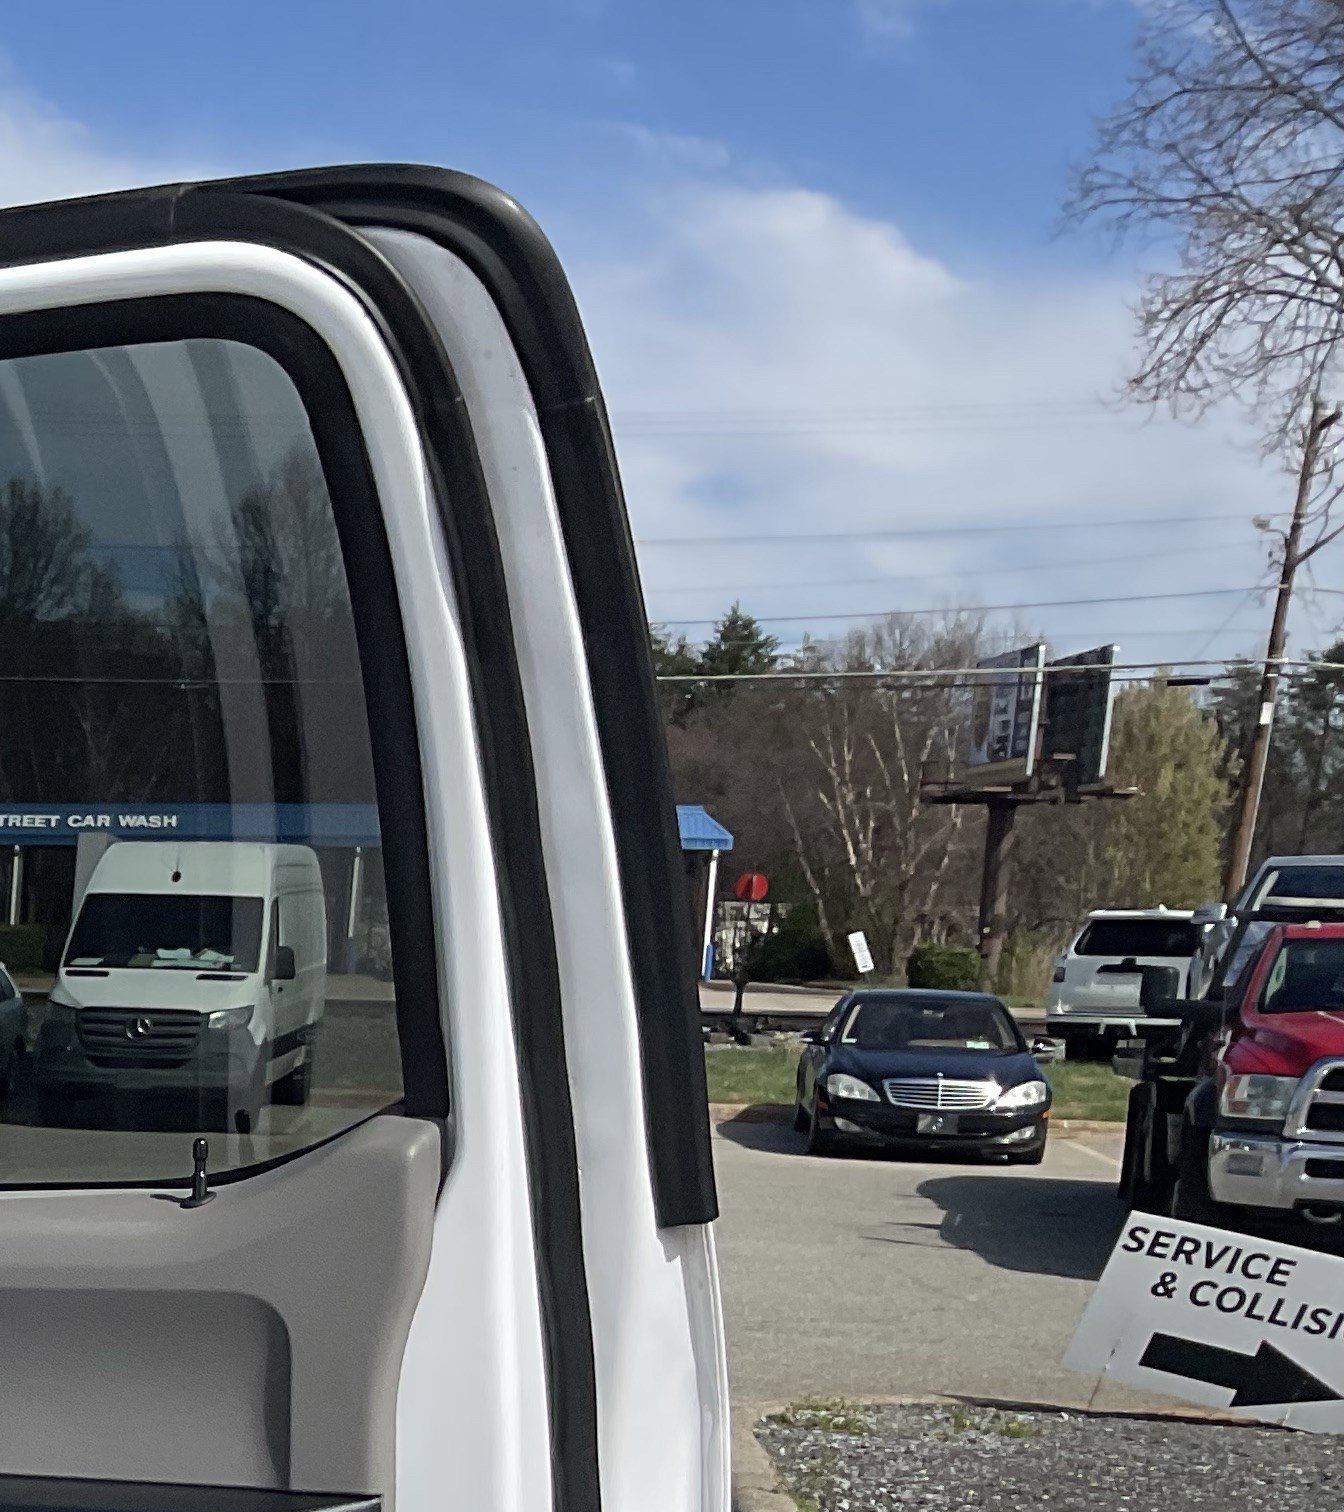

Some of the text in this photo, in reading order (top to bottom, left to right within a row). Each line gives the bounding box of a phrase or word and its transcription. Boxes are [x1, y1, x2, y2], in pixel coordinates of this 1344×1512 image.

[67, 814, 112, 829] CAR
[118, 814, 178, 829] WASH
[1121, 1226, 1298, 1287] SERVICE
[1150, 1271, 1178, 1299] &
